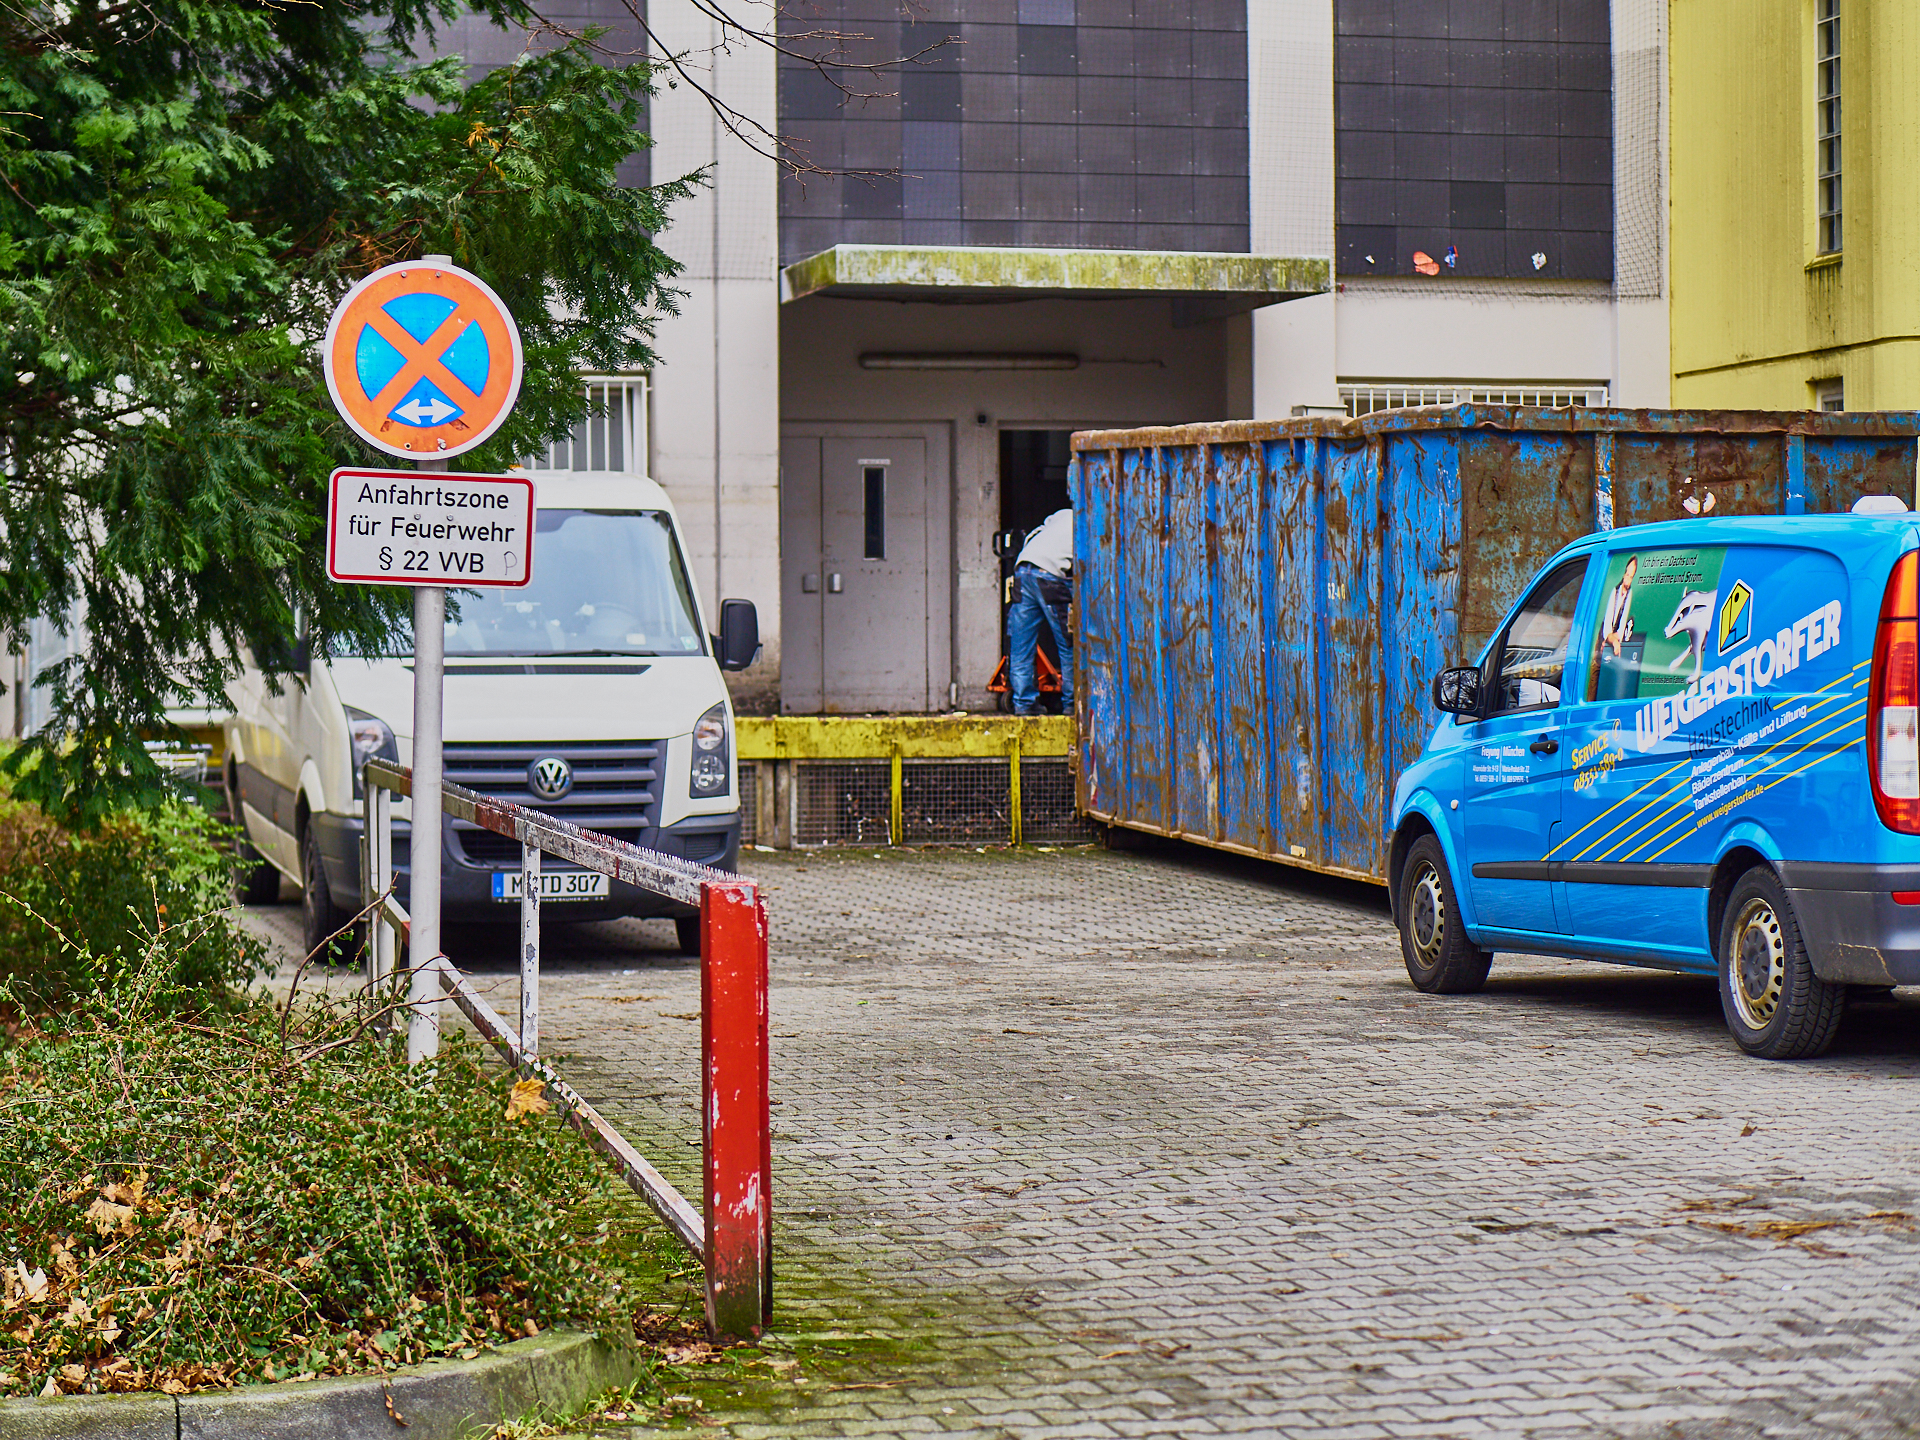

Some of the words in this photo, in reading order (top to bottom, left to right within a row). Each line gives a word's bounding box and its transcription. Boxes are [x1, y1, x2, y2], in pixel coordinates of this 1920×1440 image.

[357, 482, 509, 509] Anfahrtszone
[348, 514, 382, 536] für
[391, 516, 515, 543] Feuerwehr
[378, 546, 393, 571] §
[403, 550, 430, 571] 22
[438, 551, 485, 573] VVB
[1668, 555, 1686, 567] Dachs
[1635, 598, 1842, 753] WEIGERSTORFER
[1688, 693, 1773, 760] Haustechnik
[1759, 719, 1775, 739] und
[1775, 704, 1808, 730] Lüftung
[1502, 745, 1526, 757] München
[1571, 731, 1610, 771] SERVICE
[1691, 758, 1745, 795] Bäderzentrum
[1692, 774, 1747, 812] Tankstellenbau
[1696, 783, 1765, 829] www.weigerstorfer.de
[566, 874, 600, 893] 307
